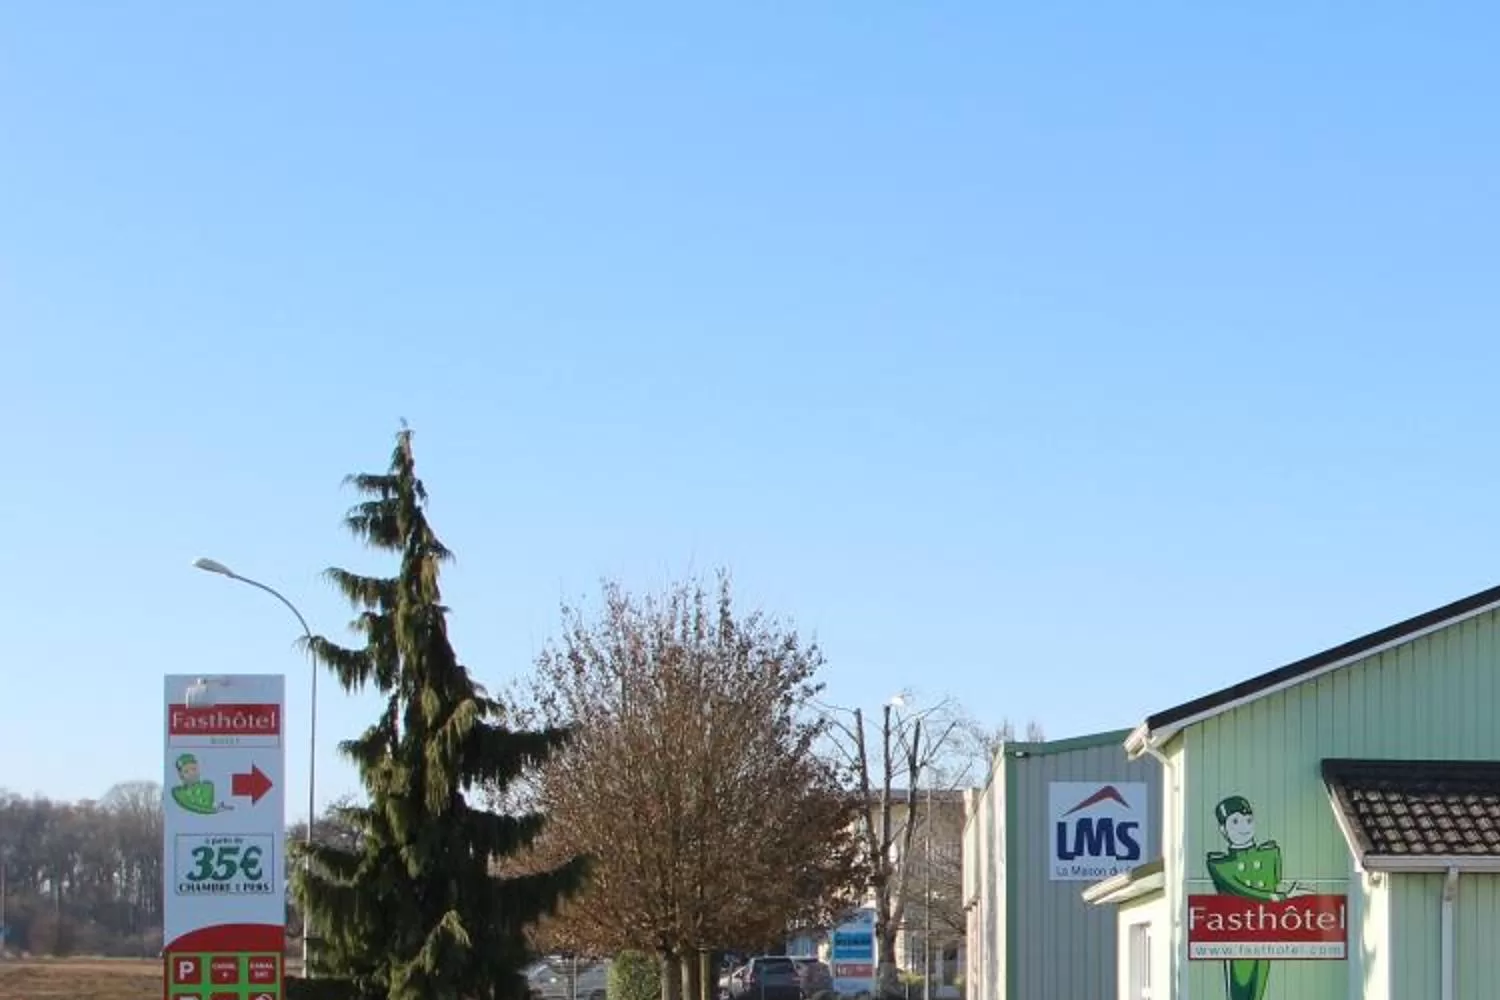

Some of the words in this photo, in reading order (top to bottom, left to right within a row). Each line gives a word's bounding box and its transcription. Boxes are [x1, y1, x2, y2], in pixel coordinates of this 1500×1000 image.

[172, 711, 276, 729] Fasthôtel
[1057, 817, 1141, 860] LMS
[186, 845, 263, 881] 35€
[1189, 903, 1345, 931] Fasthôtel
[179, 961, 194, 980] P
